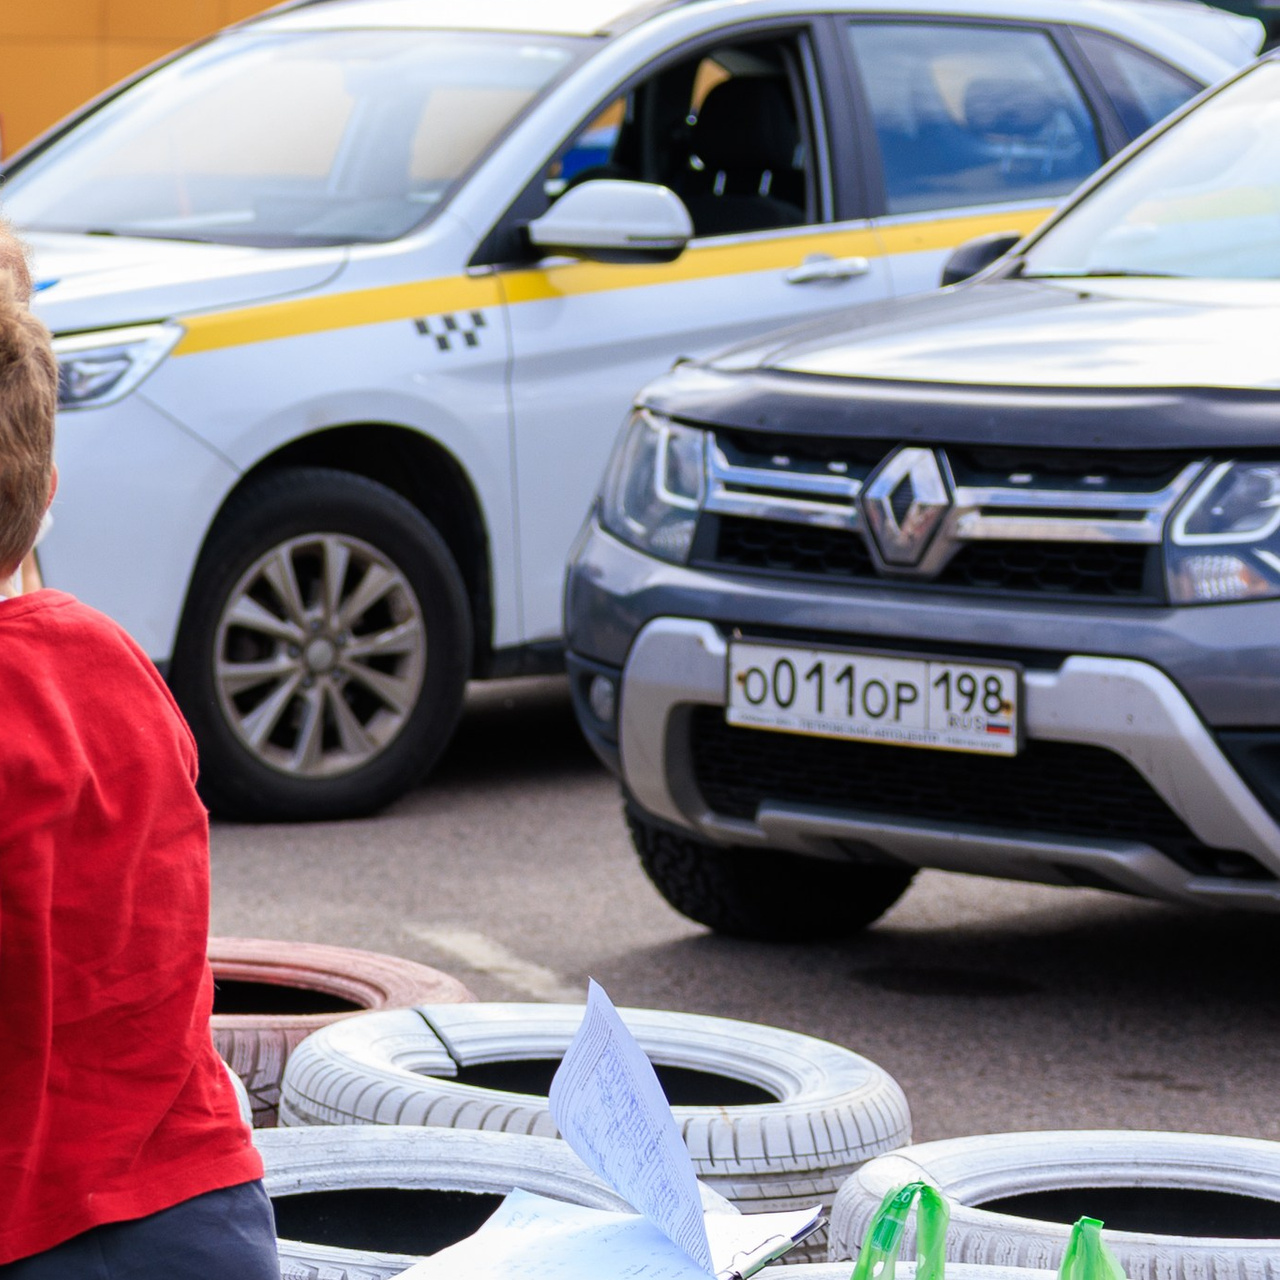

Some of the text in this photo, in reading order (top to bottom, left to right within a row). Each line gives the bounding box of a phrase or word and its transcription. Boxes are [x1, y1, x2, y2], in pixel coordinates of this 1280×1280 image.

[743, 658, 1004, 721] О011ОР 198
[947, 712, 986, 732] RUS
